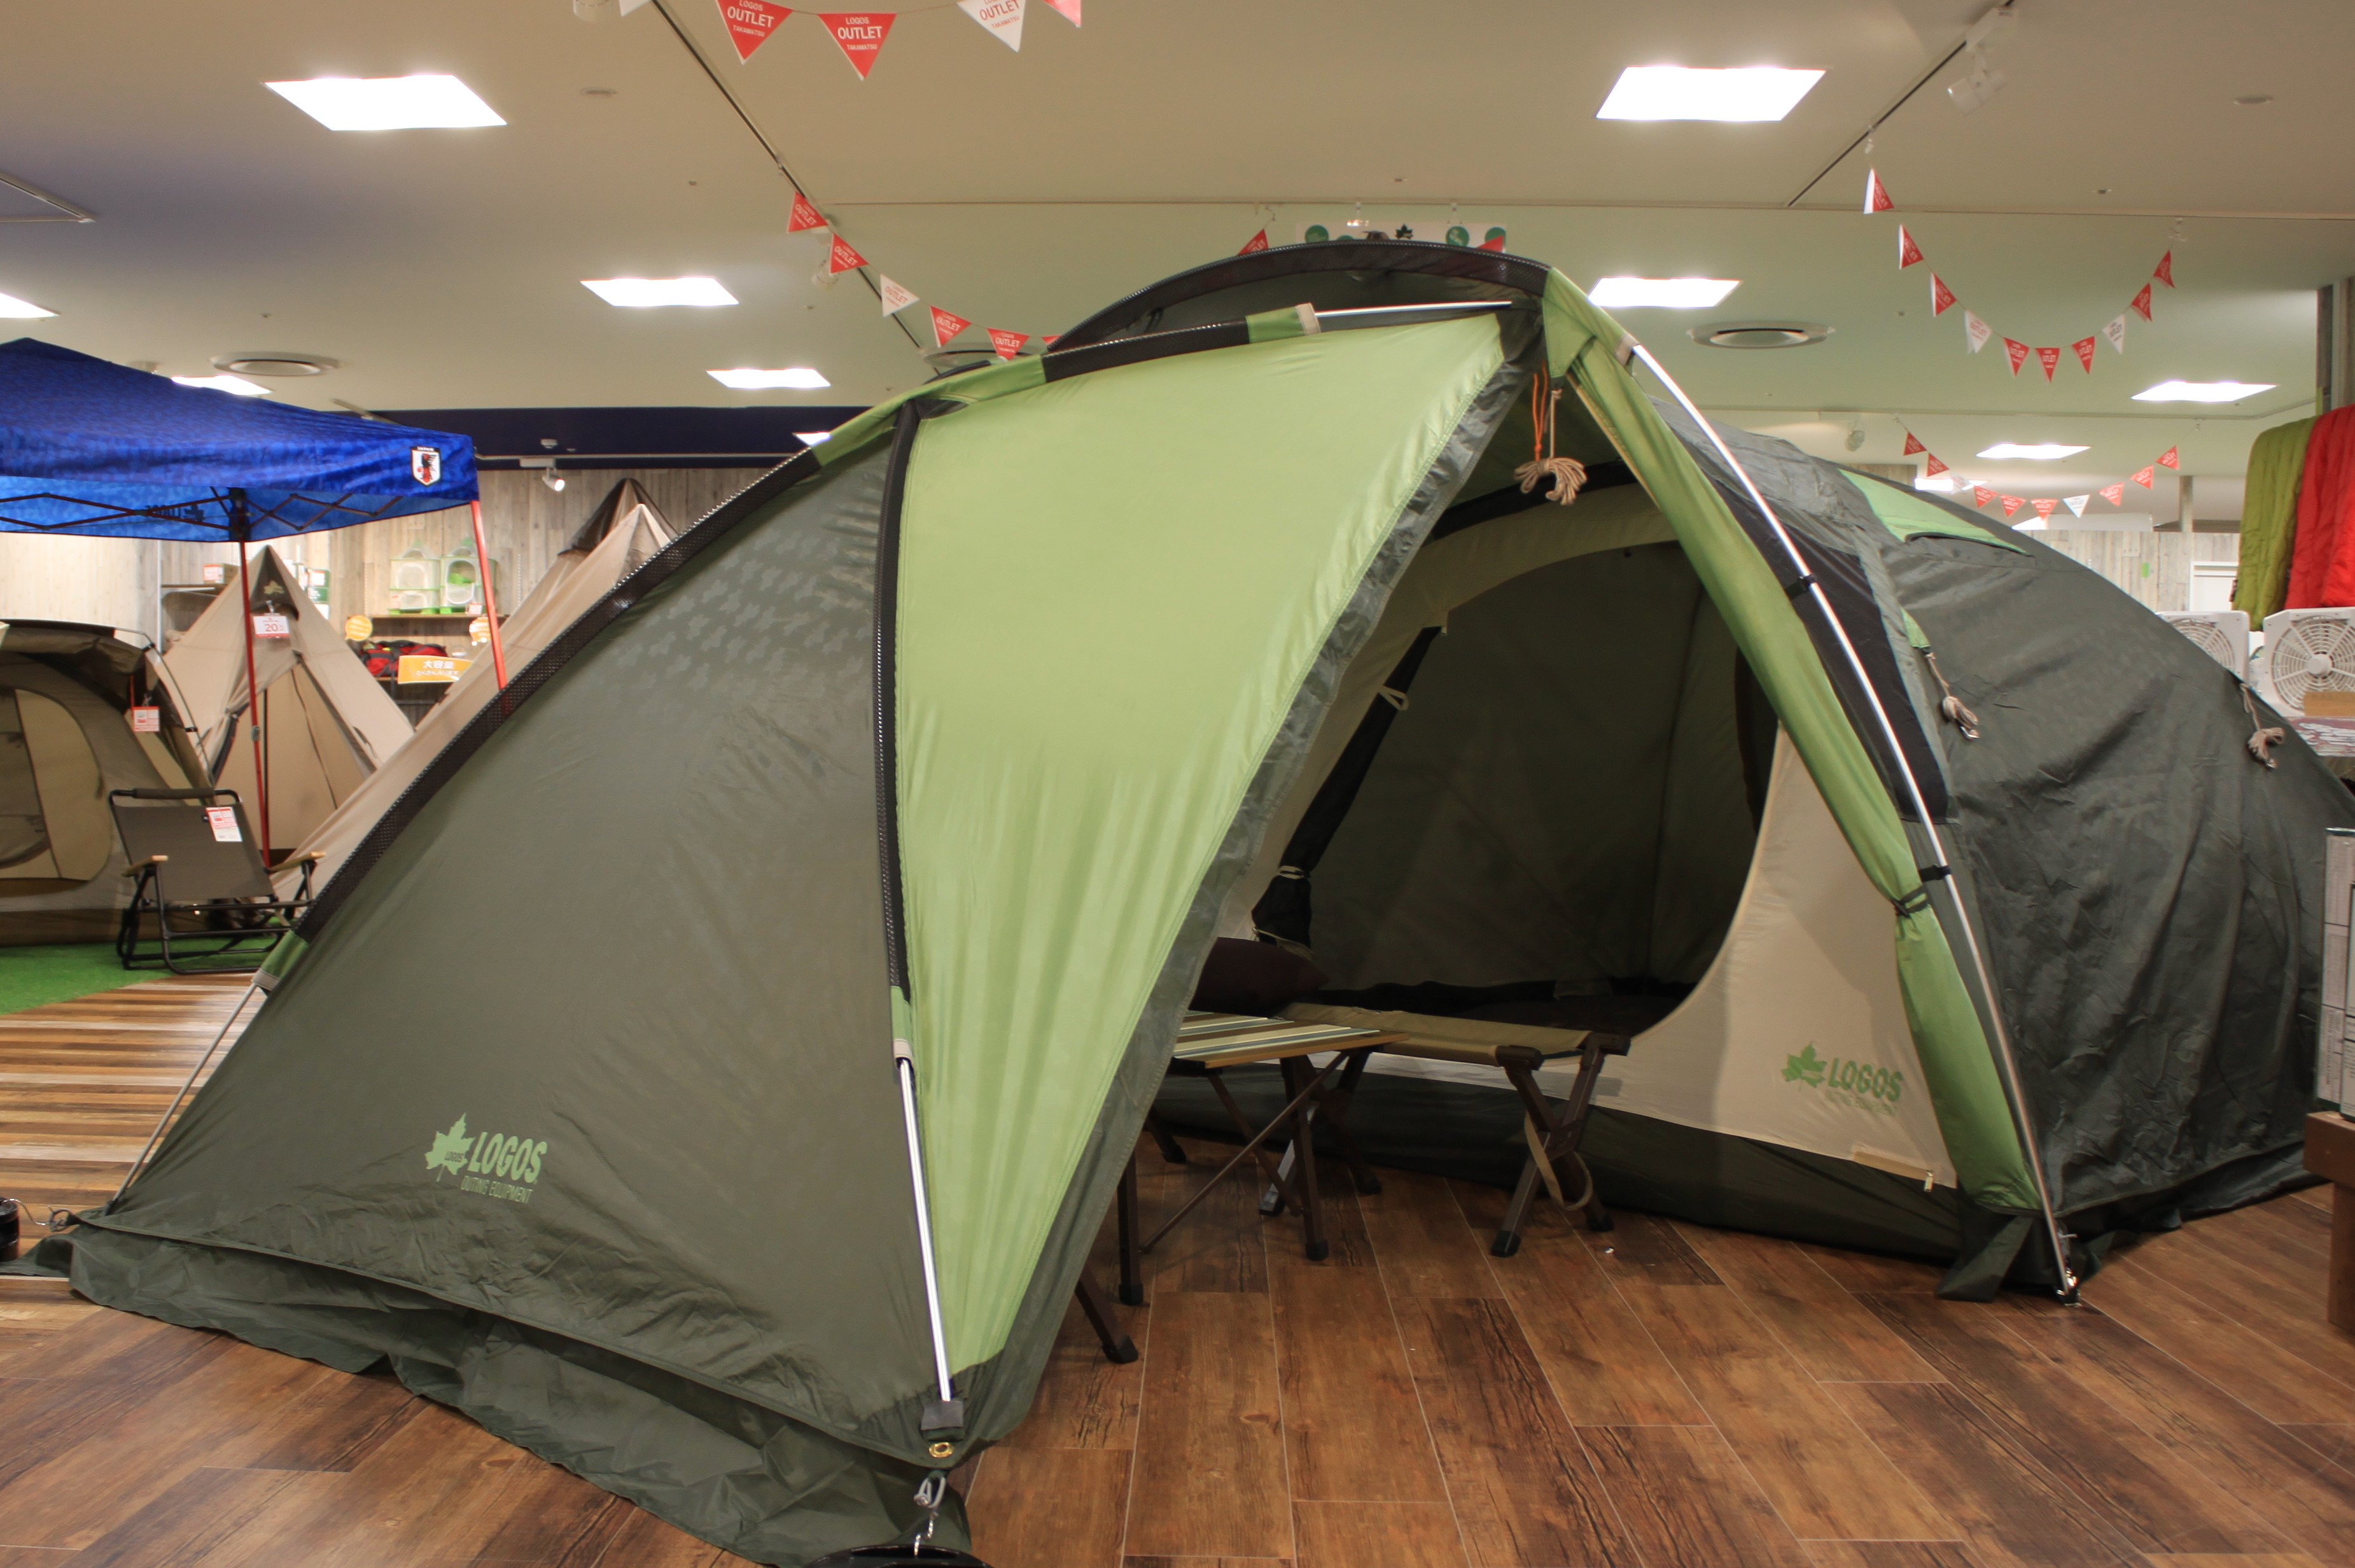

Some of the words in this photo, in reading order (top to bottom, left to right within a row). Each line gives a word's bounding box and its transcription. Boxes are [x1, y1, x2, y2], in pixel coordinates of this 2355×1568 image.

[739, 0, 763, 11] LOGOS
[979, 0, 1019, 21] OUTLET
[727, 6, 774, 28] OUTLET
[845, 17, 869, 25] LOGOS
[837, 25, 883, 39] OUTLET
[794, 204, 817, 226] OUTLET
[834, 246, 858, 266] OUTLET
[884, 286, 909, 304] OUTLET
[935, 316, 961, 332] OUTLET
[995, 337, 1021, 347] OUTLET
[265, 623, 278, 632] 20
[1828, 1057, 1904, 1102] LOGOS
[468, 1131, 548, 1184] LOGOS
